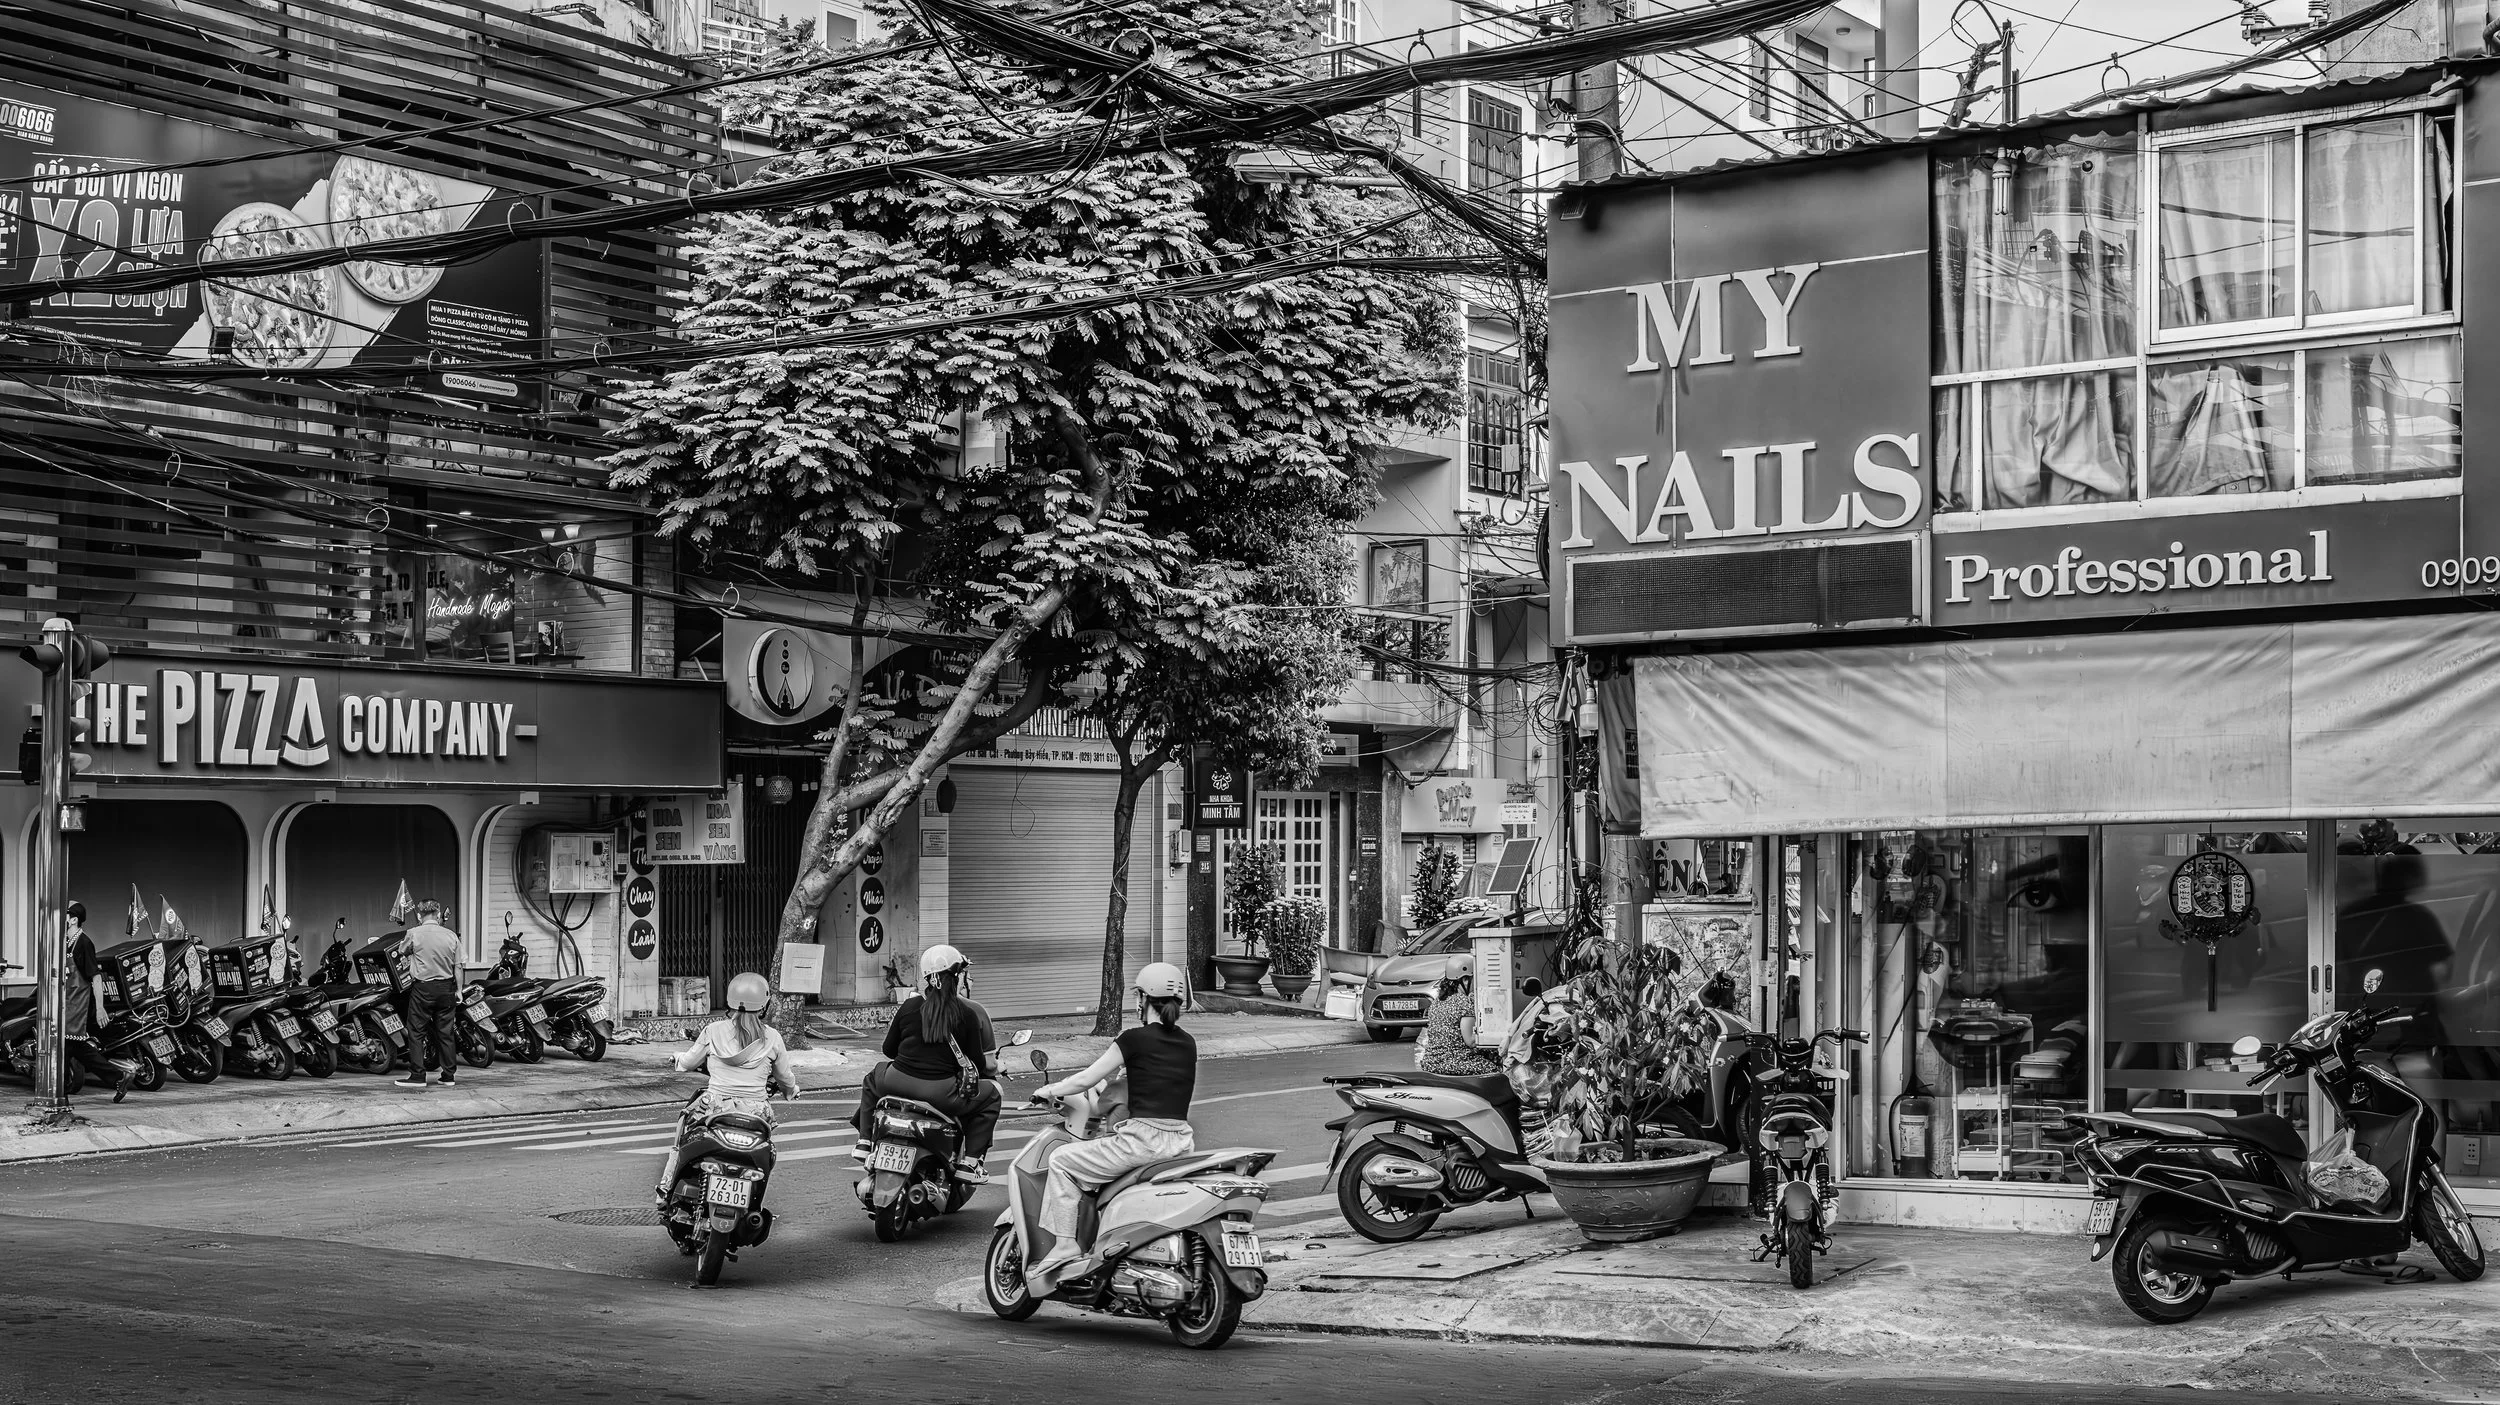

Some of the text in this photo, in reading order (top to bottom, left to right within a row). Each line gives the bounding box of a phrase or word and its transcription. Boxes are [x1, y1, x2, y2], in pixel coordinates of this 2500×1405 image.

[32, 158, 70, 194] CẤP
[112, 169, 131, 204] VỊ
[135, 172, 183, 202] NGON
[131, 206, 184, 261] LỰA
[29, 197, 119, 307] X2
[1626, 262, 1819, 373] MY
[445, 376, 476, 388] 19006066
[1559, 433, 1922, 549] NAILS
[1945, 529, 2333, 603] Professional
[2422, 556, 2500, 587] 0909
[427, 596, 473, 618] Handmade
[480, 593, 510, 619] Magic
[159, 668, 330, 767] PIZZA
[342, 695, 514, 757] COMPANY
[653, 808, 683, 827] HOA
[706, 803, 731, 819] HOA
[1202, 805, 1240, 818] MINH TÂM
[709, 823, 730, 838] SEN
[656, 832, 681, 850] SEN
[703, 842, 737, 861] VÀNG
[630, 884, 655, 909] Chay
[863, 890, 884, 905] Nhân
[631, 927, 656, 948] Lành
[883, 1145, 909, 1160] 59-X4
[880, 1156, 910, 1172] 161.07
[716, 1177, 744, 1193] 72-D1
[710, 1189, 747, 1206] 263.05
[1229, 1235, 1255, 1250] 67-H1
[1228, 1250, 1261, 1266] 291.31
